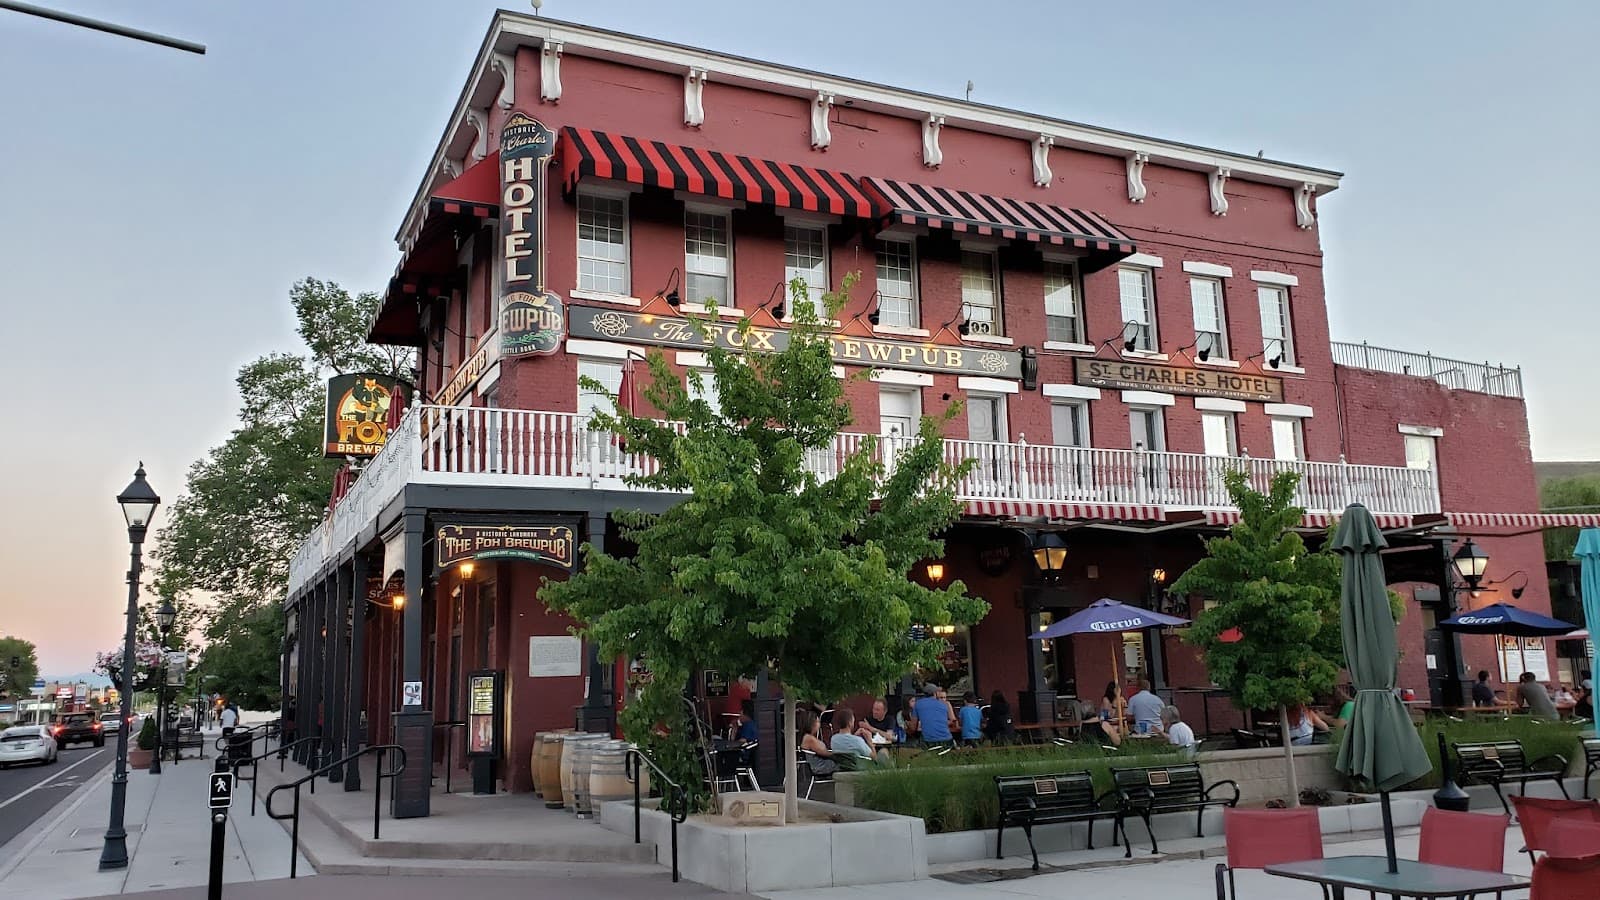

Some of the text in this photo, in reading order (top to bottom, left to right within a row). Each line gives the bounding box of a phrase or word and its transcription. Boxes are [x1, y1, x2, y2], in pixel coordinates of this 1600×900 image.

[508, 132, 546, 150] Charles
[504, 157, 535, 282] HOTEL
[502, 308, 562, 333] EWPUB
[653, 322, 963, 367] The FOX REWPUB
[1120, 365, 1207, 387] CHARLES
[1217, 374, 1273, 393] HOTEL
[337, 443, 384, 454] BREWP
[446, 537, 472, 558] THE
[505, 538, 566, 559] BREWPUB
[1090, 616, 1142, 631] Cuervo
[1458, 616, 1504, 625] Cuervo
